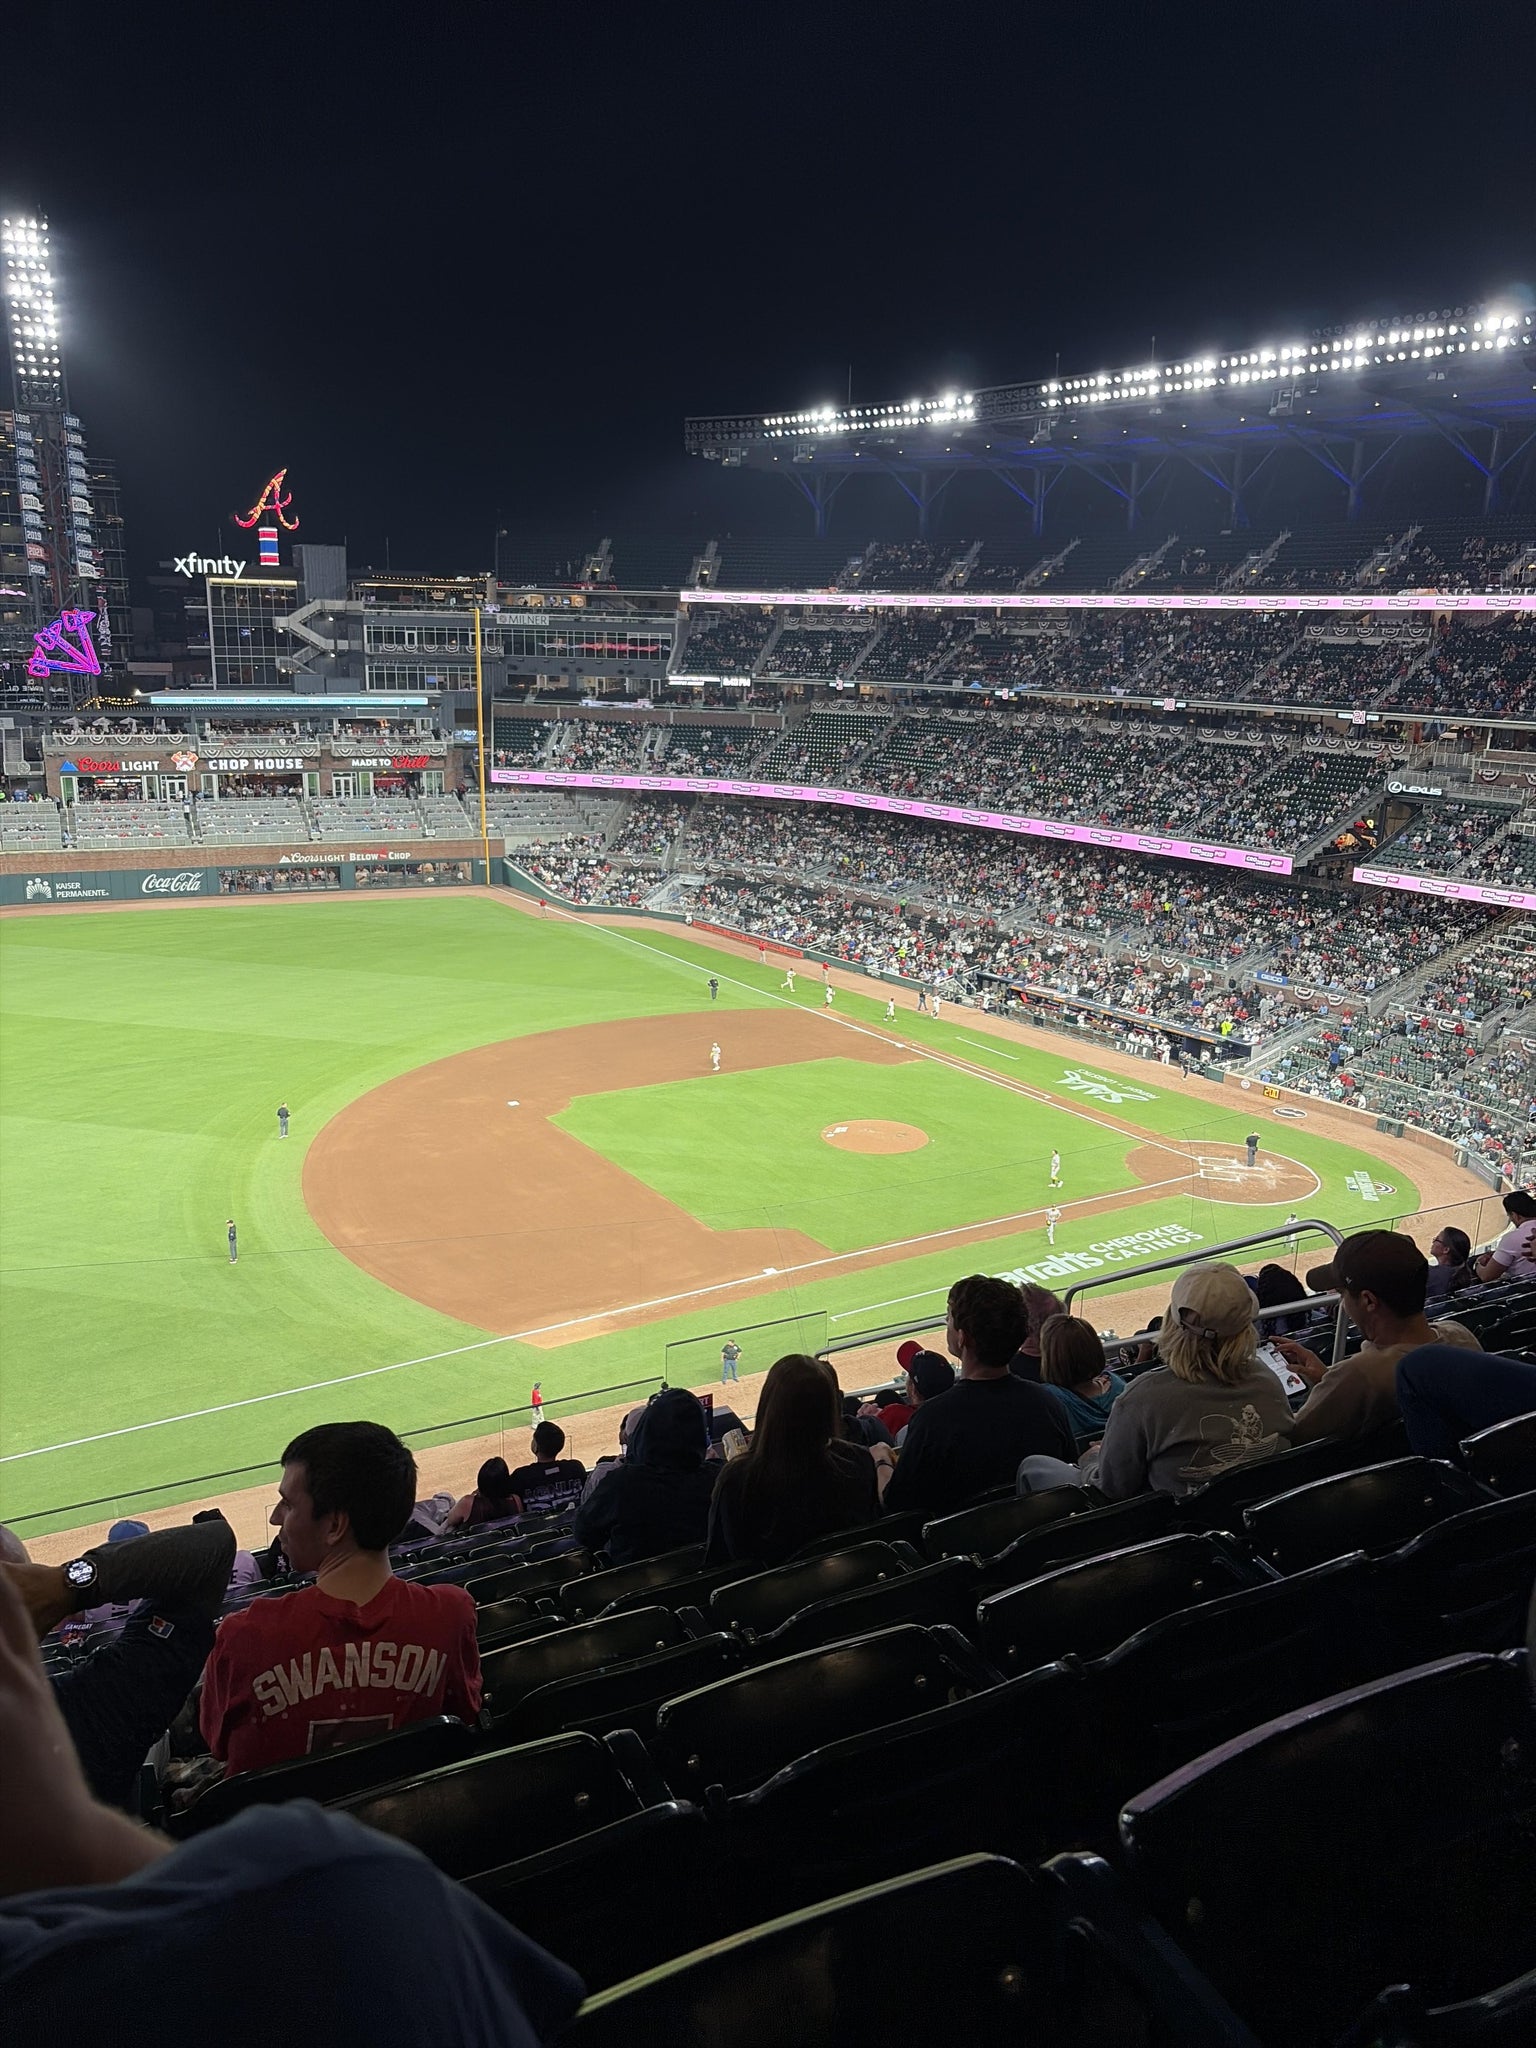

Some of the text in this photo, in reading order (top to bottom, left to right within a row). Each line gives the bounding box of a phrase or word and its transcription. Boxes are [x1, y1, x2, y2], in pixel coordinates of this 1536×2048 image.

[65, 416, 80, 427] 1997
[67, 433, 82, 444] 1999
[18, 447, 34, 457] 2000
[68, 450, 83, 460] 2001
[20, 464, 36, 474] 2002
[22, 481, 37, 491] 2004
[24, 497, 39, 506] 2010
[73, 500, 88, 510] 2012
[25, 514, 40, 523] 2013
[26, 530, 41, 540] 2019
[76, 533, 92, 543] 2020
[28, 546, 44, 556] 2021
[78, 549, 93, 559] 2022
[80, 565, 95, 575] 2024
[174, 552, 247, 579] xfinity
[508, 614, 547, 624] MILNER
[1352, 710, 1366, 724] 21
[78, 756, 159, 772] Coors LIGHT
[208, 758, 304, 770] CHOP HOUSE
[352, 755, 429, 768] MADE TO Chill
[1402, 784, 1442, 795] LEXUS
[291, 853, 319, 863] Coors
[350, 853, 378, 861] BELOW
[389, 852, 410, 860] CHOP
[55, 882, 81, 890] KAISER
[142, 872, 204, 893] Coca-Cola
[56, 889, 106, 898] PERMANENTE
[1261, 973, 1283, 983] GEICO
[1088, 1223, 1191, 1253] CHEROKEE
[1104, 1231, 1204, 1261] CASINOS
[252, 1641, 447, 1717] SWANSON
